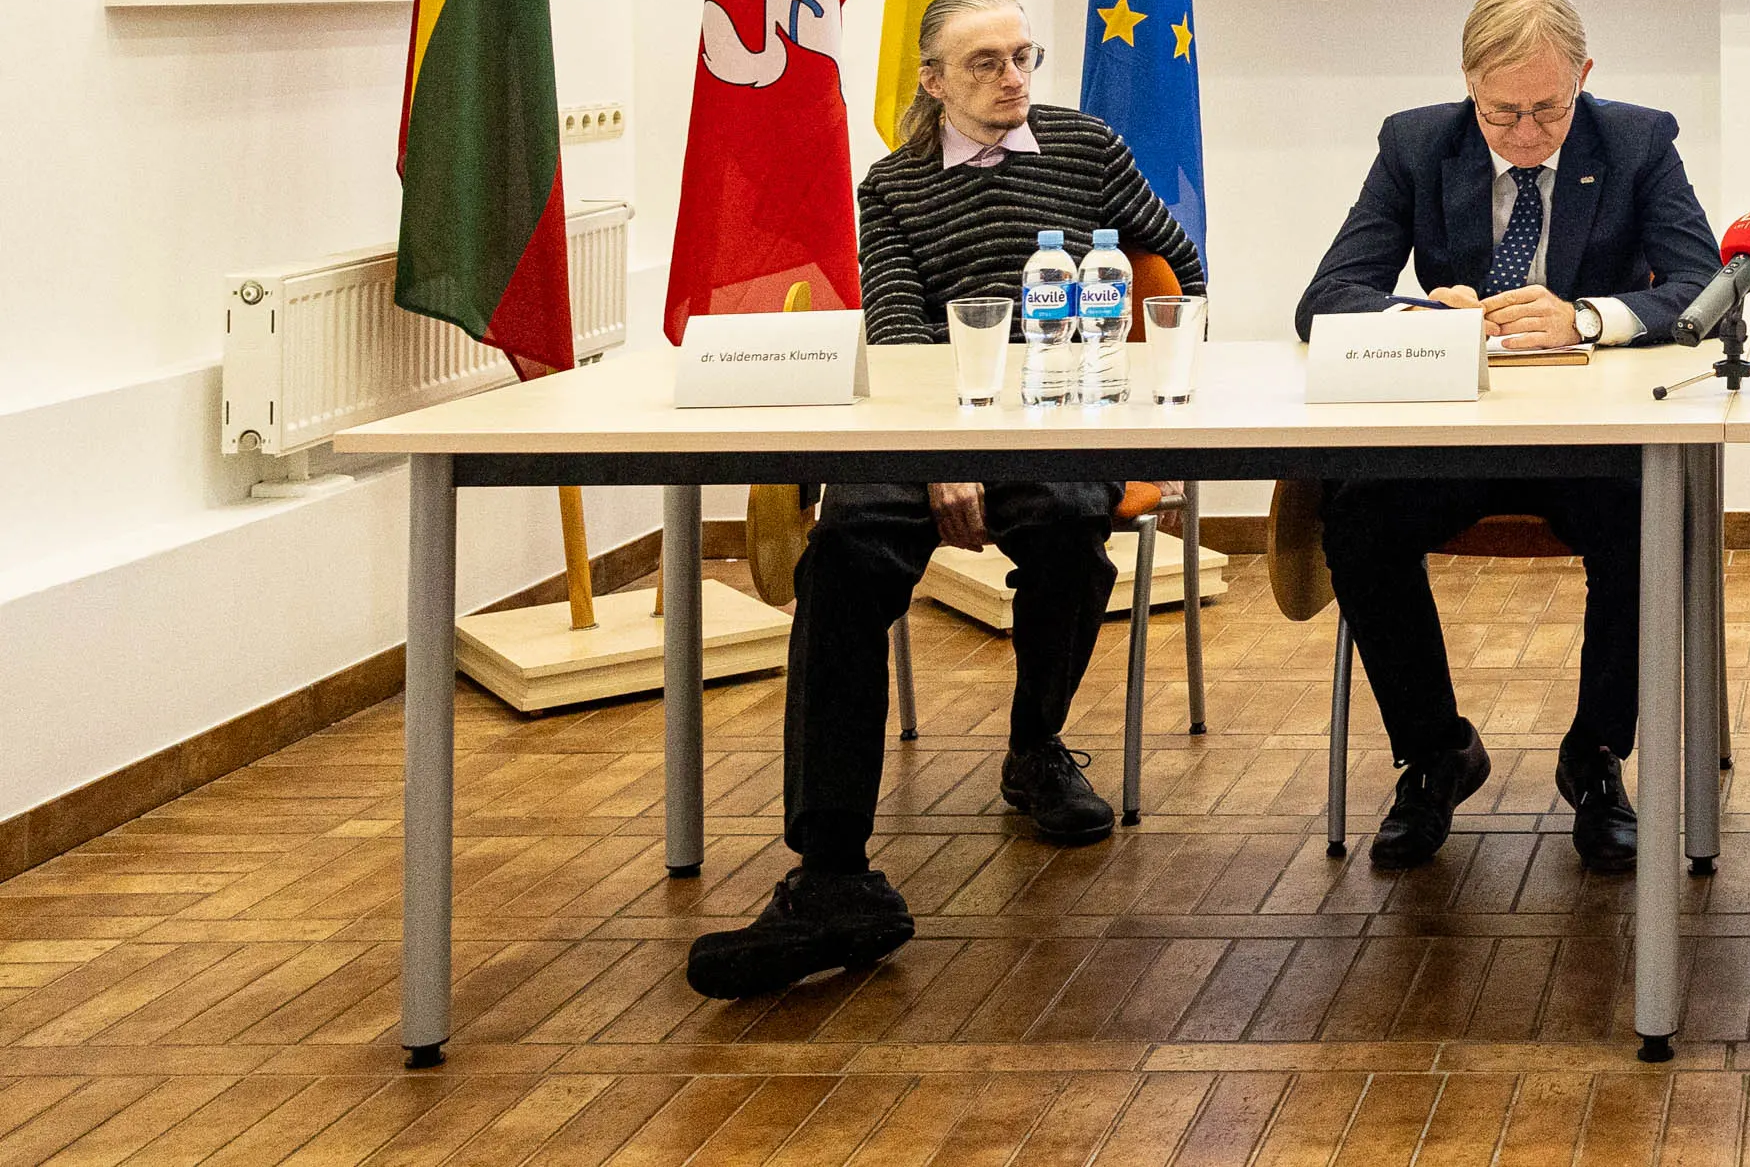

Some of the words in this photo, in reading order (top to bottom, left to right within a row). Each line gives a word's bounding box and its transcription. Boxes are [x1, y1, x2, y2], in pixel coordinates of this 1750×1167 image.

[1028, 290, 1065, 303] akvilė
[1081, 289, 1119, 302] akvilė
[701, 352, 715, 363] dr.
[719, 350, 786, 363] Valdemaras
[789, 349, 838, 362] Klumbys
[1345, 349, 1359, 360] dr.
[1363, 348, 1402, 359] Arūnas
[1405, 348, 1446, 359] Bubnys
